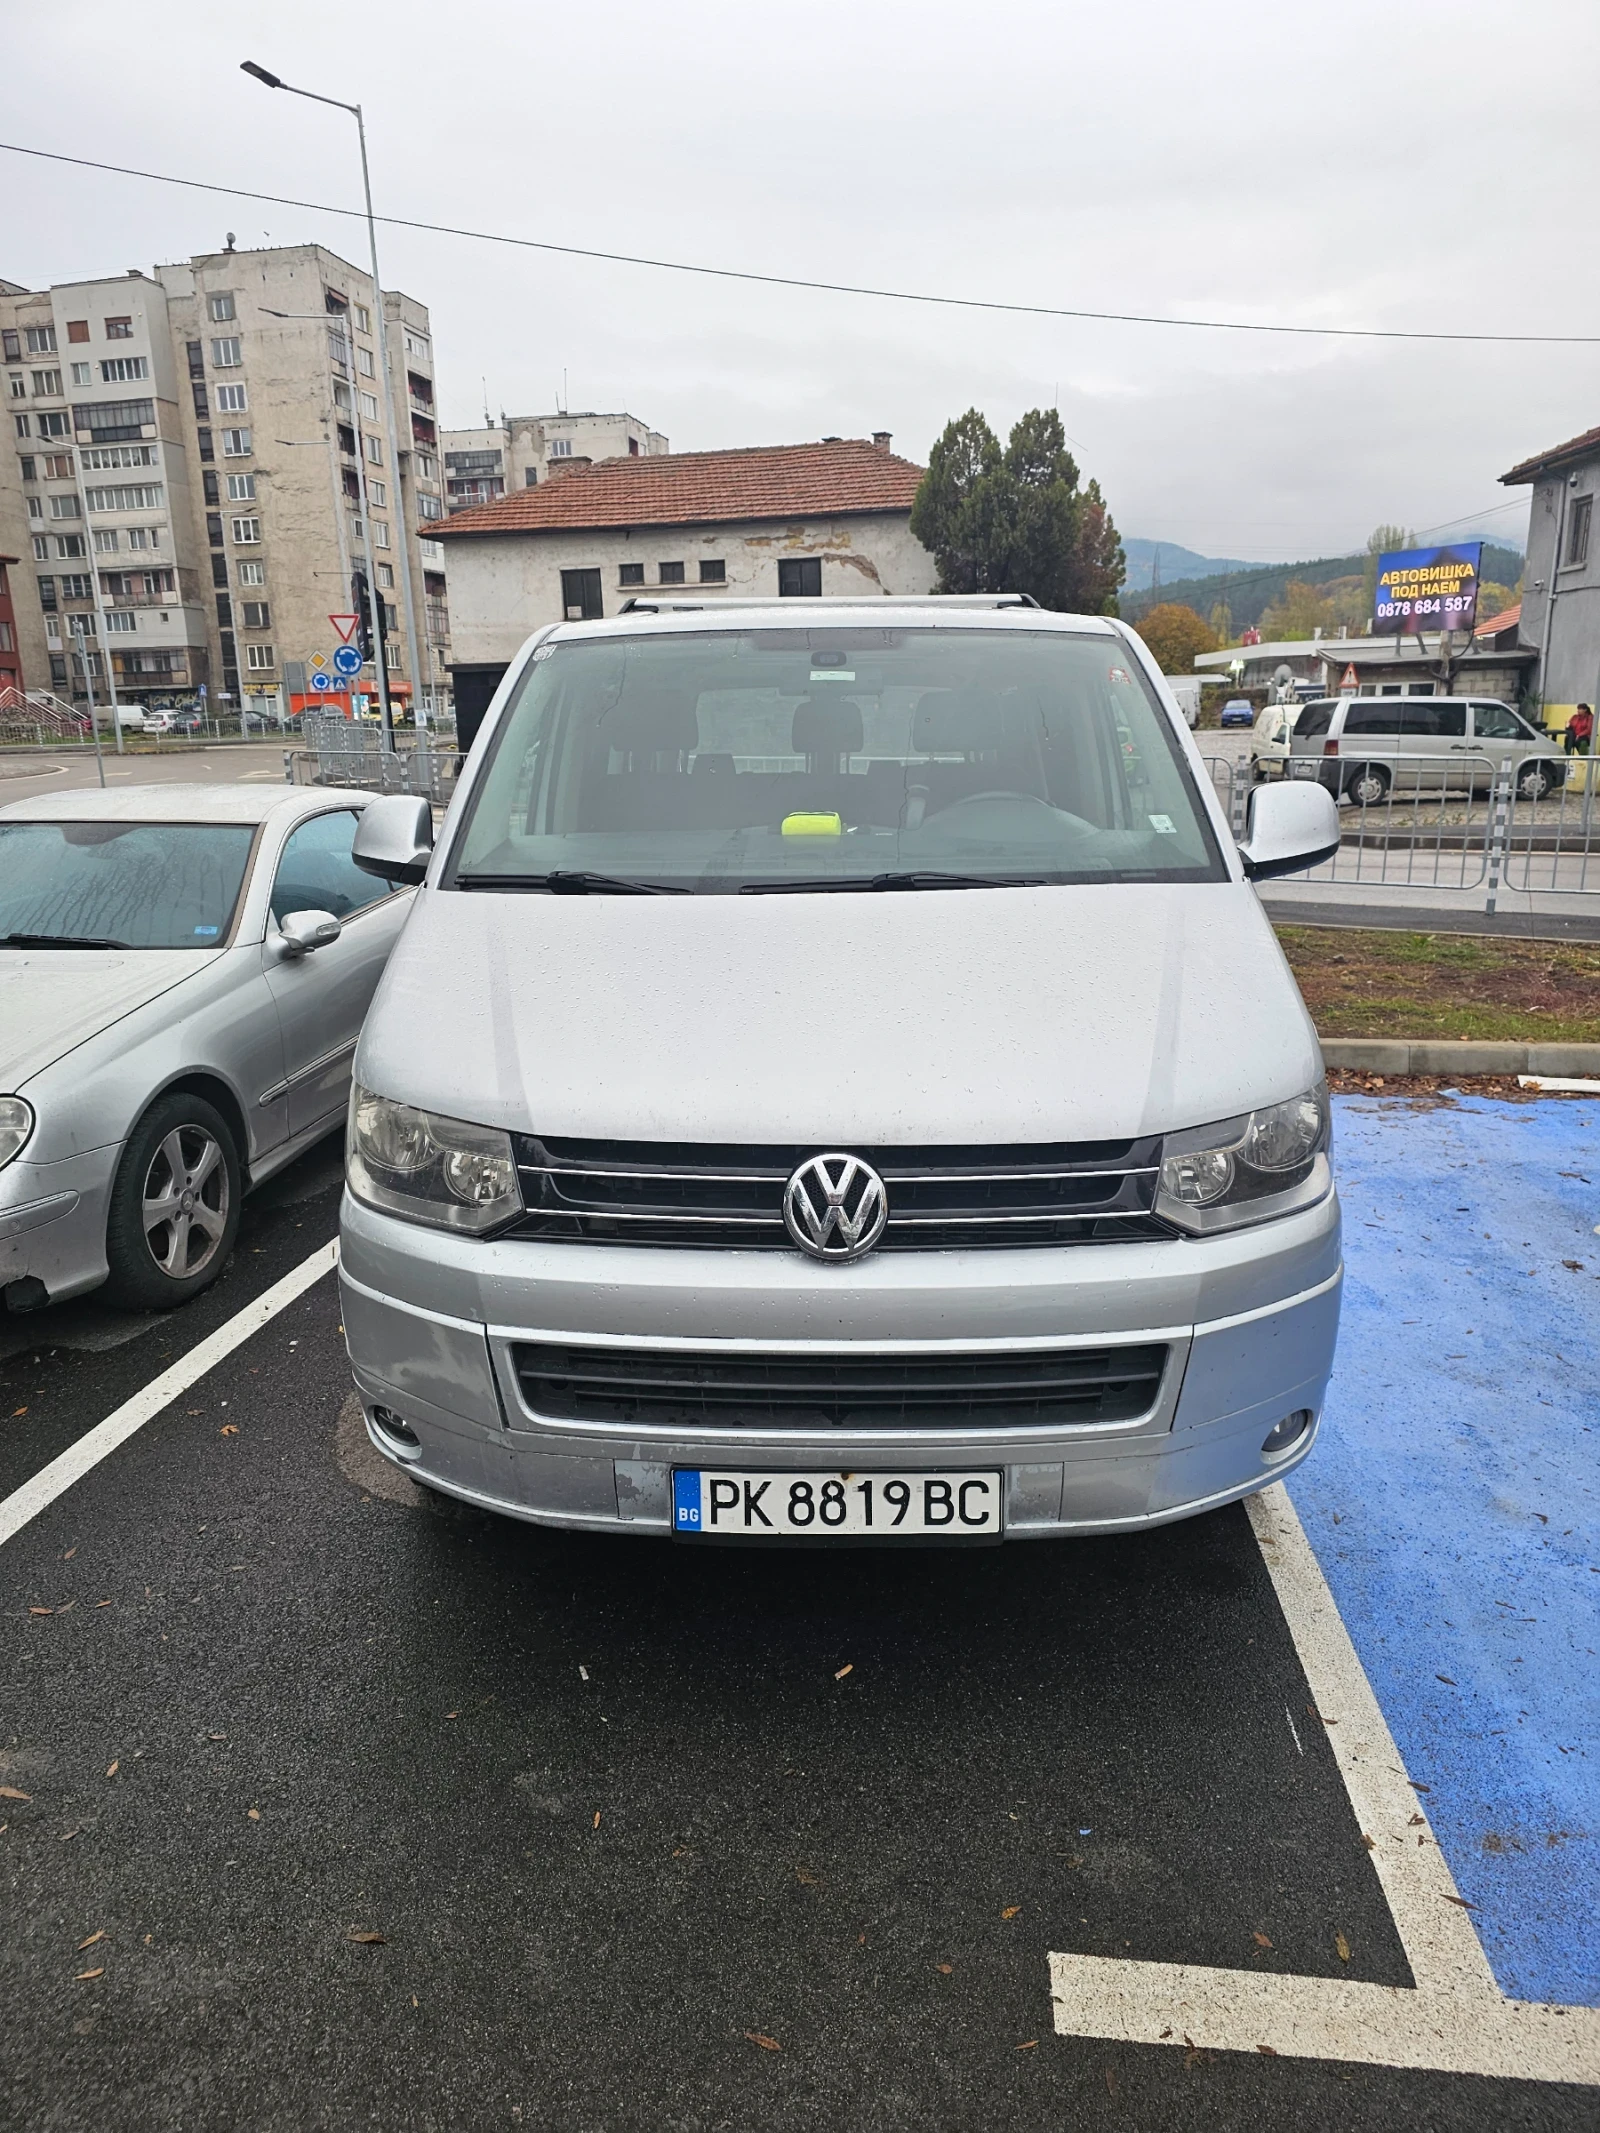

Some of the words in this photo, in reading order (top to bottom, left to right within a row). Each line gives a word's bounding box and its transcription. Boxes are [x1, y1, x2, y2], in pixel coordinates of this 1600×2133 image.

[1380, 563, 1475, 585] АВТОВИШКА
[1391, 586, 1418, 598] ПОД
[1421, 580, 1460, 595] НАЕМ
[1377, 602, 1411, 617] 0878
[1414, 599, 1441, 614] 684
[1444, 596, 1473, 612] 587
[678, 1507, 699, 1522] BG
